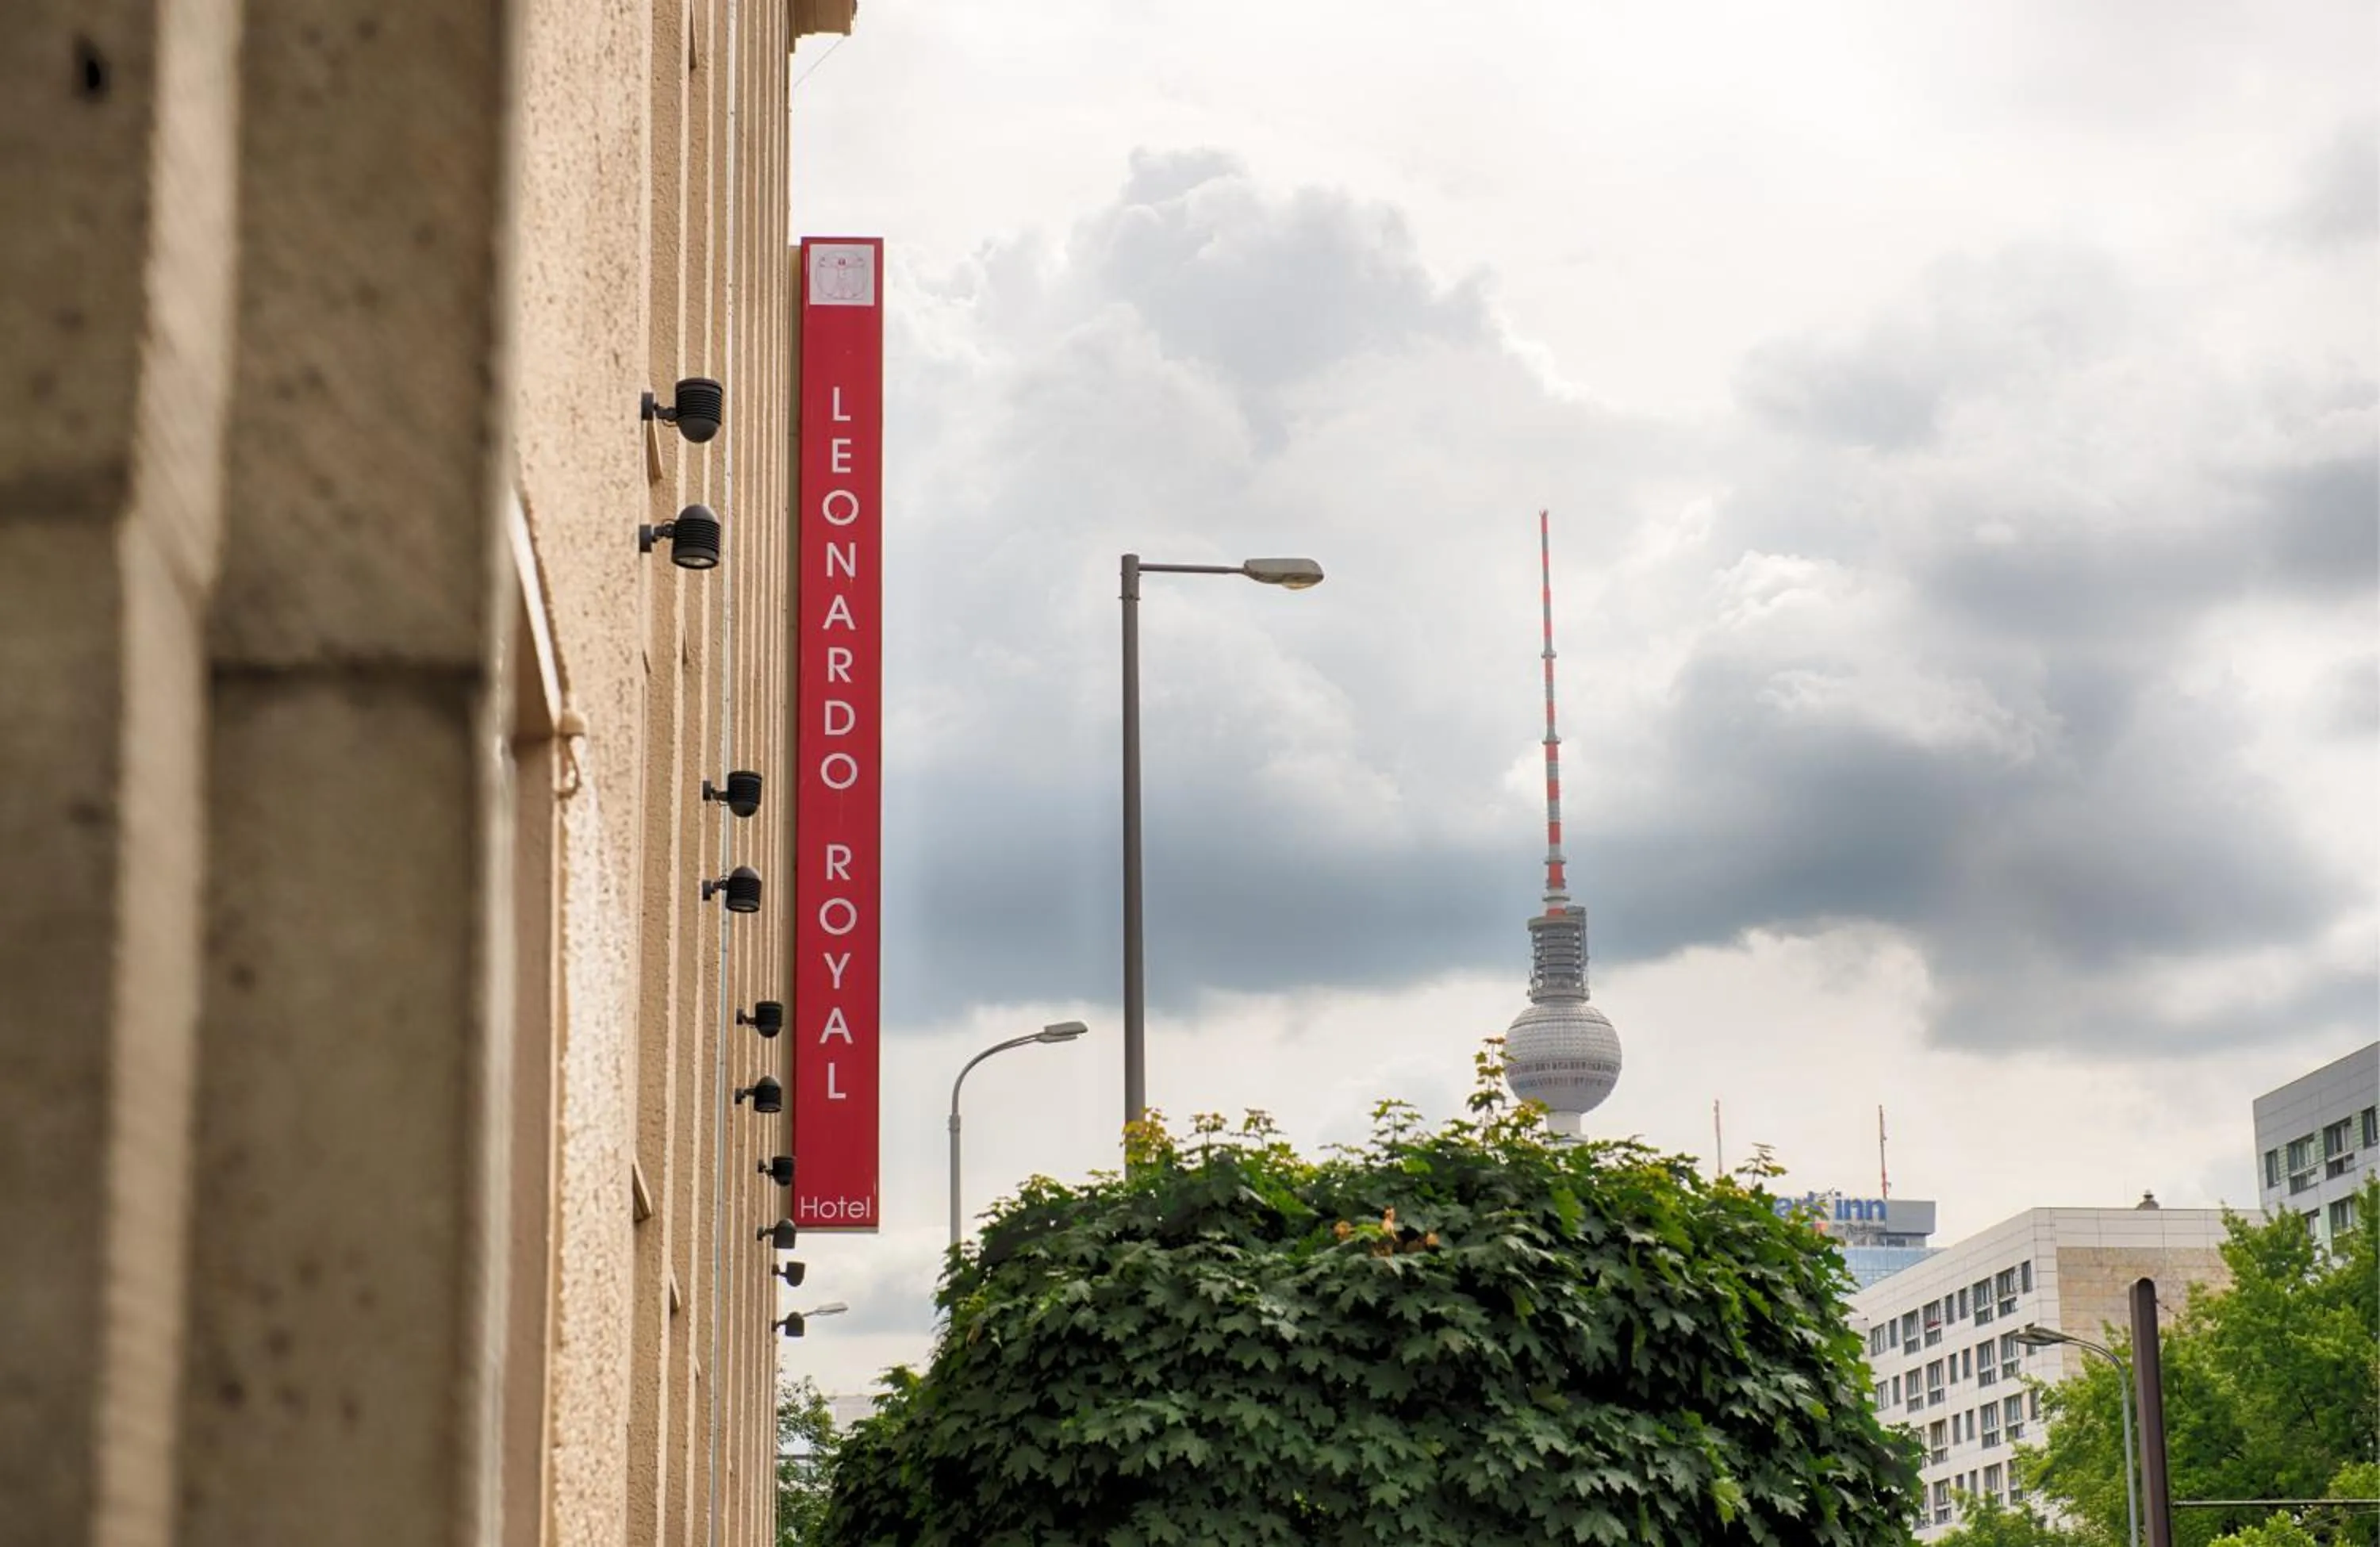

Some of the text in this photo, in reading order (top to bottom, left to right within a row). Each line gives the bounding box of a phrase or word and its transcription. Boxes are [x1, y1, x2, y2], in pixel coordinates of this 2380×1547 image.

[819, 386, 859, 1099] LEONARDO ROYAL
[800, 1196, 870, 1219] Hotel
[1835, 1192, 1887, 1220] inn
